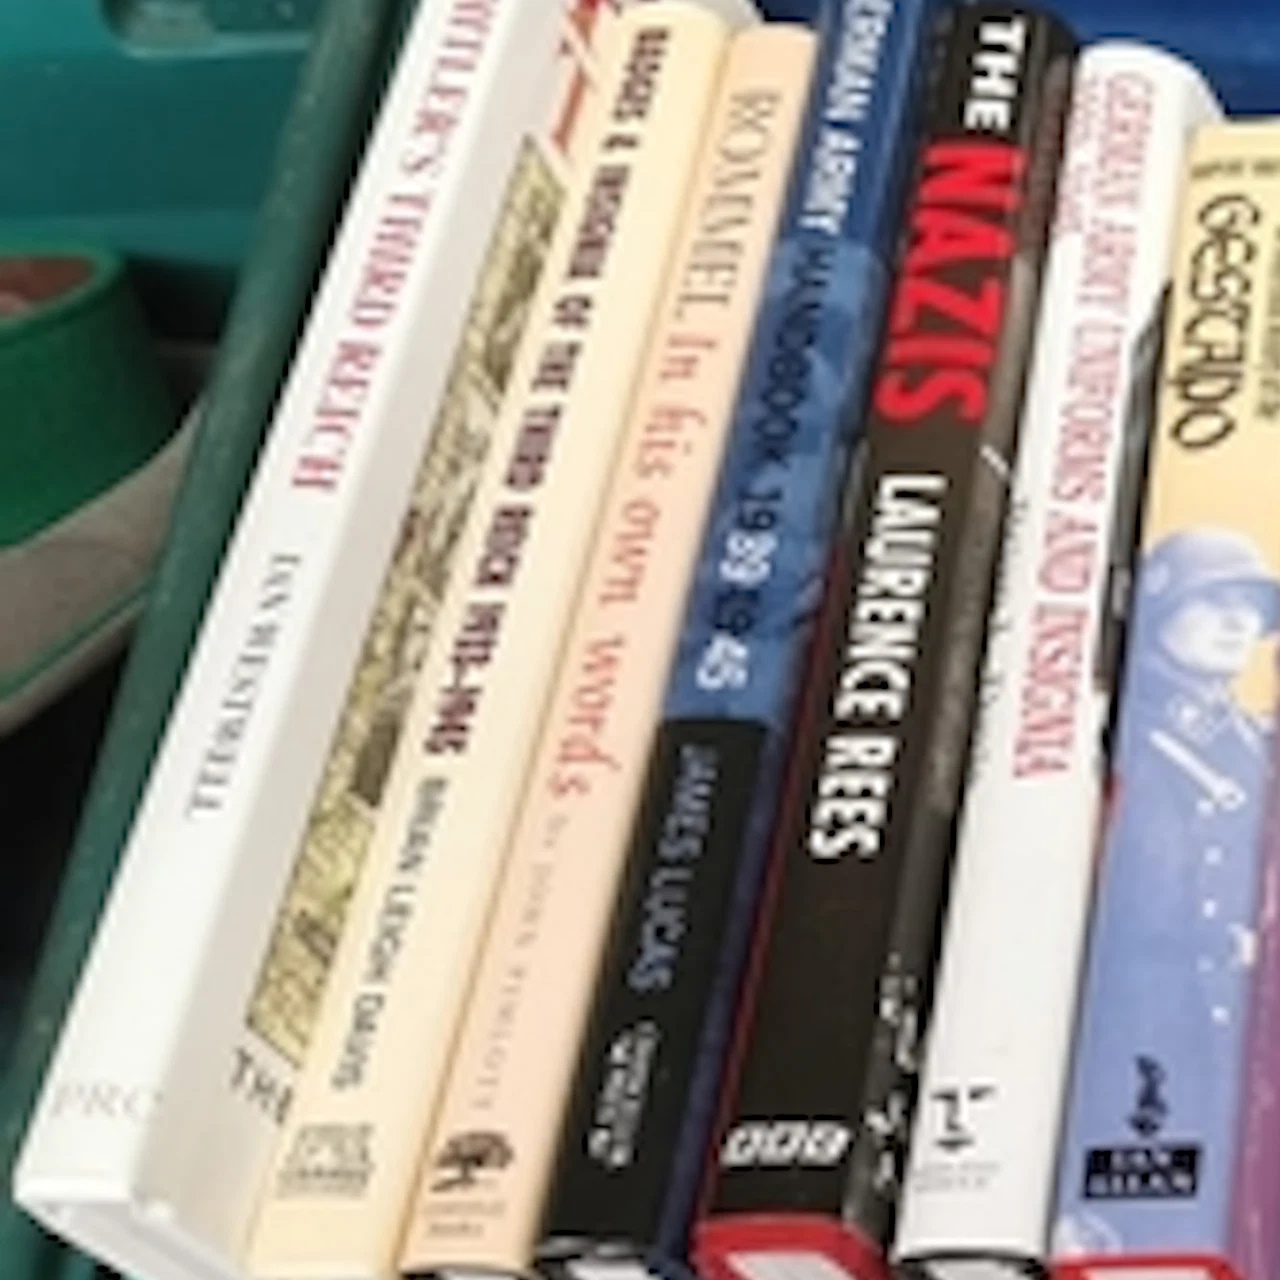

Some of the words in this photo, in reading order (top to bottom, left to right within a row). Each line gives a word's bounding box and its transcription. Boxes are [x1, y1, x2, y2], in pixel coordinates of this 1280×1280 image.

[614, 27, 670, 124] BADGES
[963, 17, 1027, 132] THE
[798, 129, 860, 235] ARMY
[1094, 71, 1156, 220] GERMAN
[352, 192, 431, 327] THIRD
[562, 163, 631, 284] INSIGNIA
[1077, 227, 1137, 319] ARMY
[553, 294, 594, 329] OF
[872, 144, 1029, 426] NAZIS
[530, 338, 583, 394] THE
[657, 333, 718, 381] In
[747, 240, 836, 475] HANDBOOK
[1050, 323, 1125, 502] UNIFORMS
[291, 340, 381, 491] REICH
[505, 404, 562, 491] THIRD
[630, 404, 708, 480] his
[259, 553, 301, 610] IAN
[473, 505, 535, 588] REICH
[599, 498, 661, 605] own
[832, 472, 949, 724] LAURENCE
[1038, 510, 1098, 593] AND
[188, 622, 279, 812] WESTWELL
[547, 634, 627, 798] words
[1012, 603, 1091, 782] INSIGNIA
[396, 777, 450, 872] BRIAN
[662, 743, 722, 858] JAMES
[807, 732, 898, 862] REES
[363, 884, 416, 986] LEIGH
[627, 868, 694, 995] LUCAS
[330, 992, 385, 1091] DAVIS
